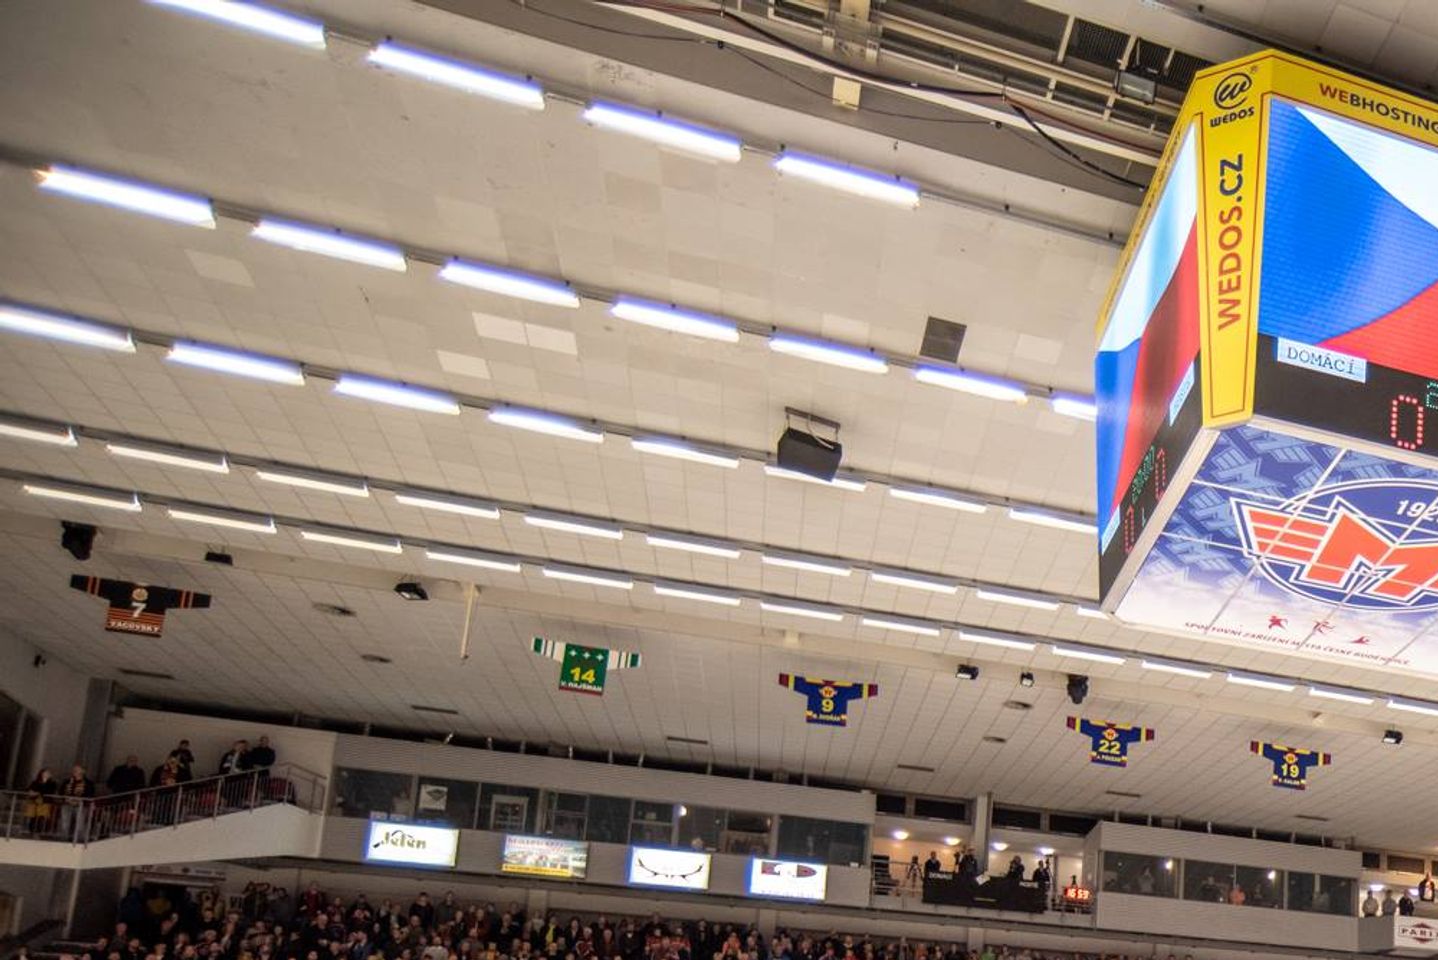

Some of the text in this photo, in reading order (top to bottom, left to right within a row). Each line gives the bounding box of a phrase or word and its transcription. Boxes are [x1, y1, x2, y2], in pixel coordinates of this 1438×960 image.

[1210, 106, 1255, 128] WEDOS
[1218, 153, 1244, 331] WEDOS.CZ
[1286, 346, 1357, 375] DOMÁCÍ
[1390, 395, 1424, 450] 0
[131, 602, 147, 618] 7
[570, 667, 595, 684] 14
[821, 698, 834, 713] 9
[1098, 739, 1121, 754] 22
[1281, 764, 1299, 778] 19
